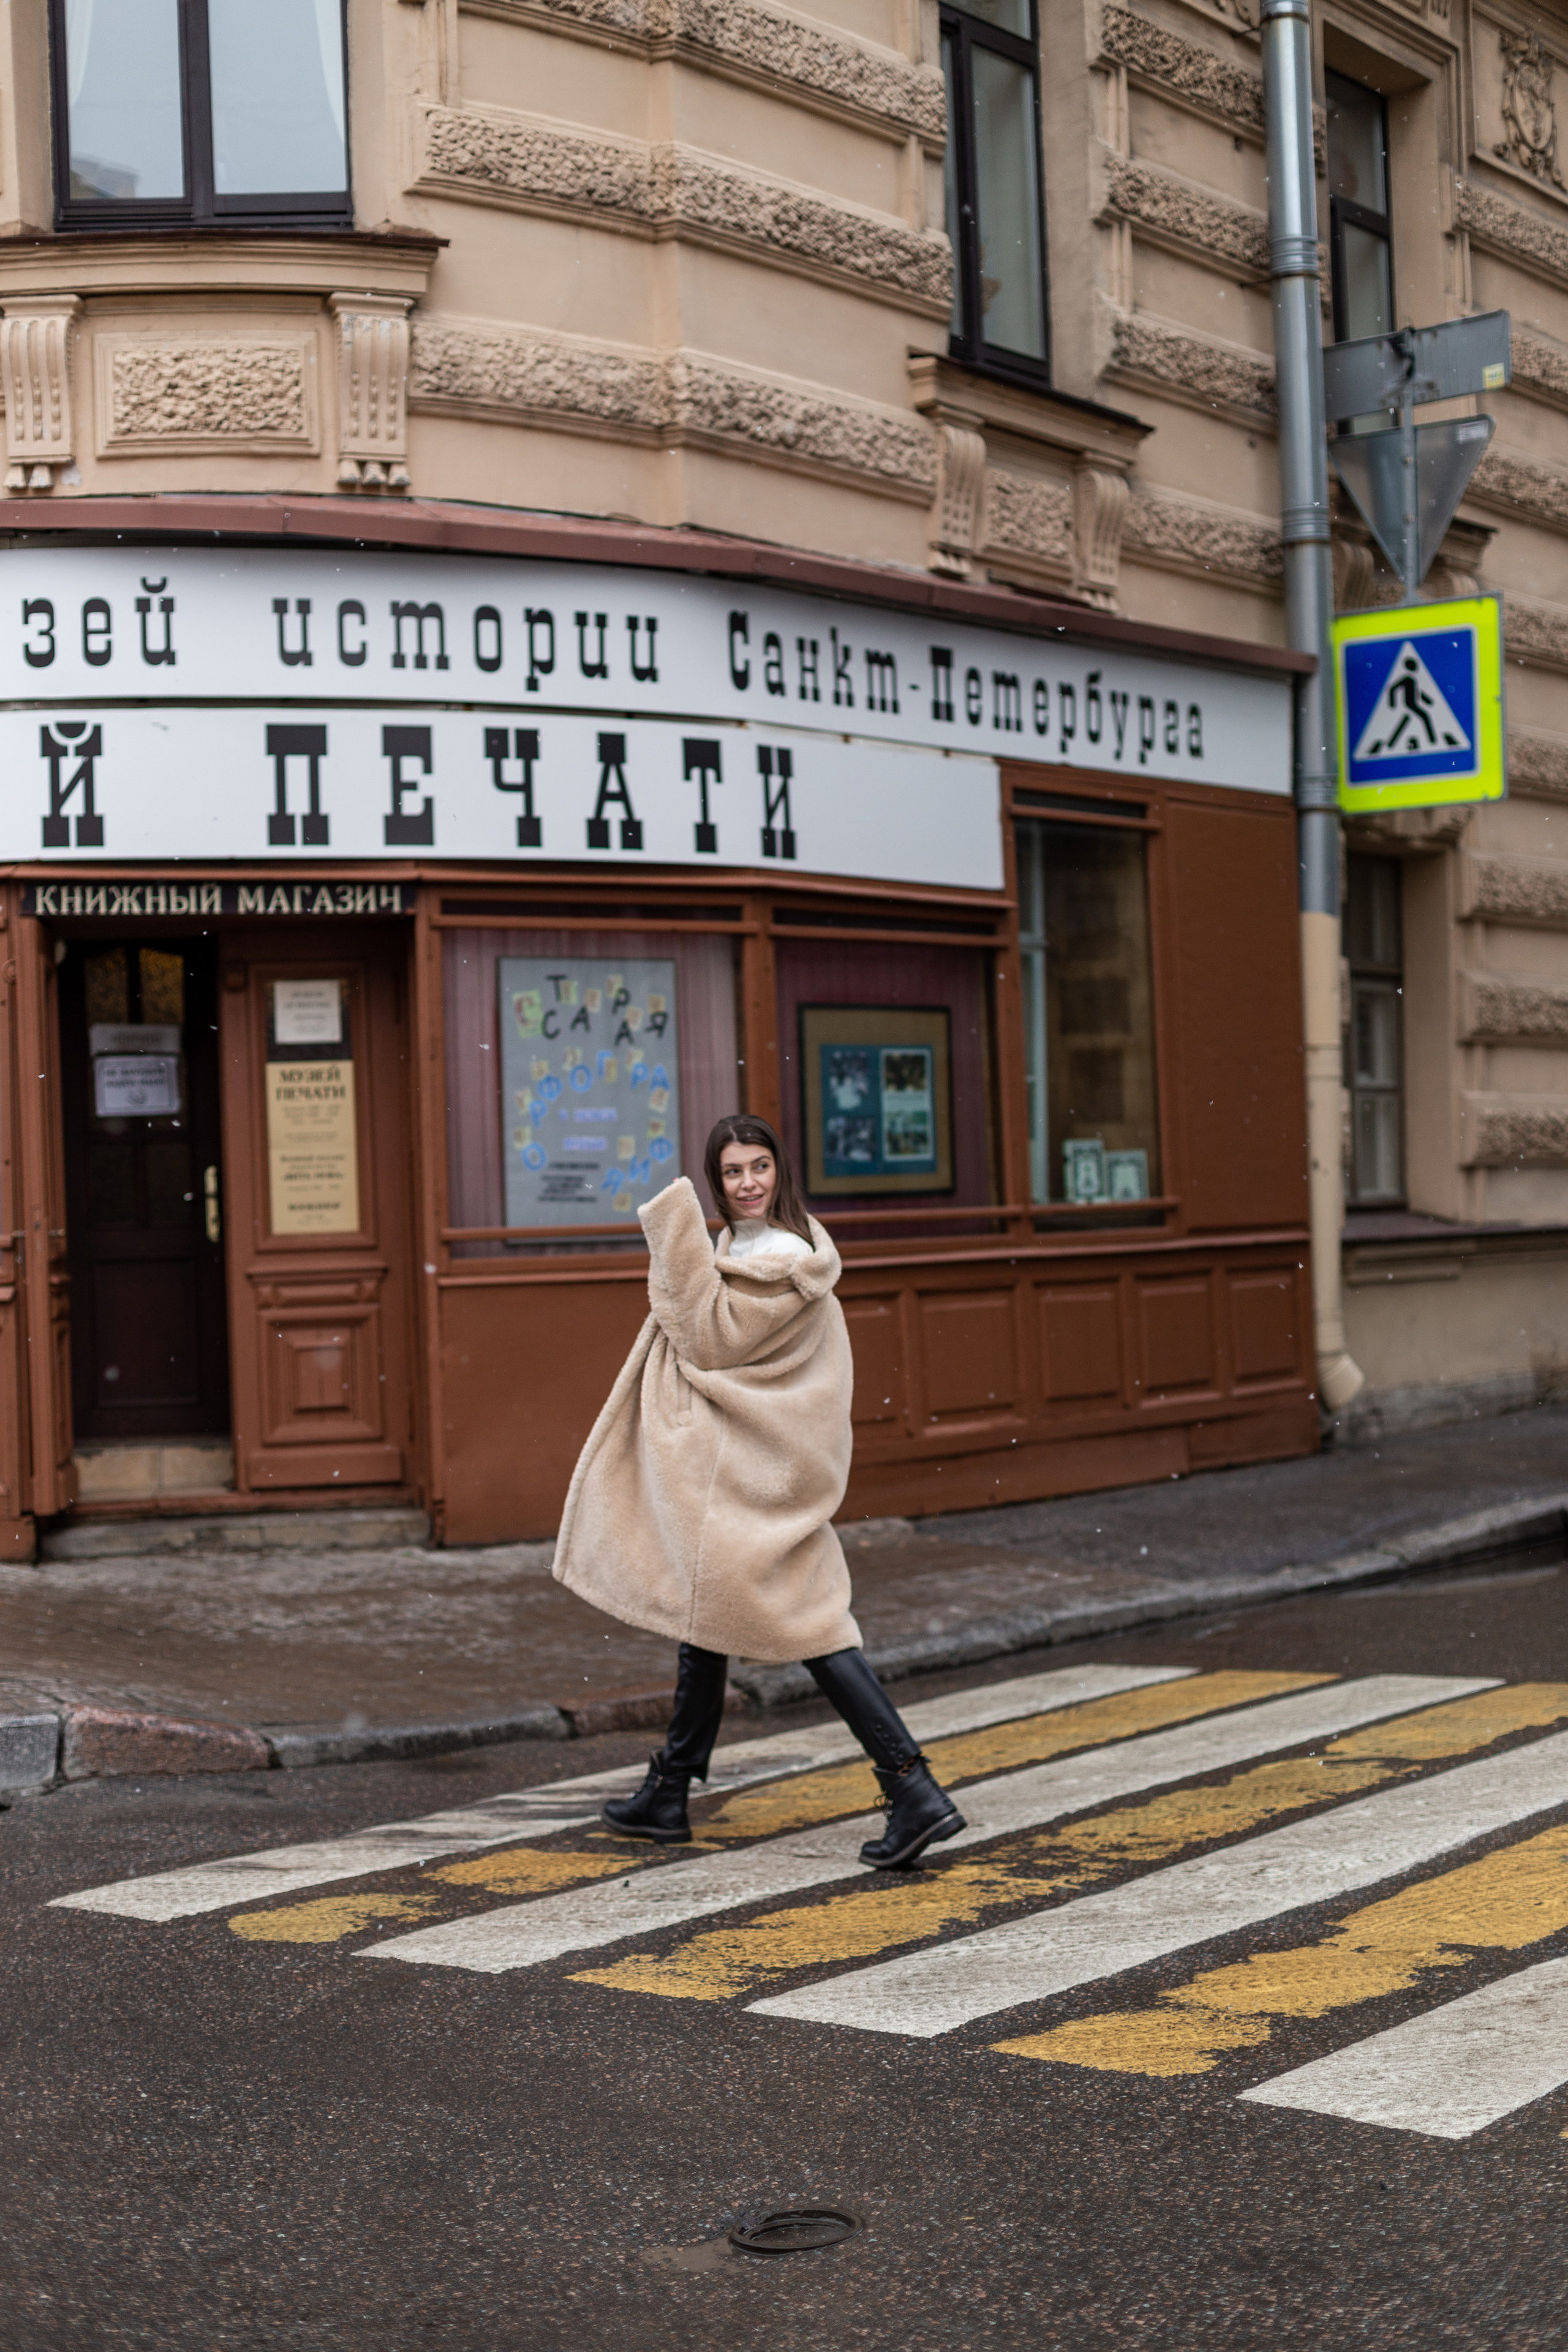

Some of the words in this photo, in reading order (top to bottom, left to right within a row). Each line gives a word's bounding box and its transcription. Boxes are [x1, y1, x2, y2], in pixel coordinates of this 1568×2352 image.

[271, 598, 659, 692] истории
[728, 609, 1204, 766] Санкт-Петербурга
[264, 722, 797, 860] ПЕЧАТИ
[34, 883, 224, 916] КНИЖНЫЙ
[237, 884, 402, 914] МАГАЗИН
[279, 1065, 341, 1083] МУЗЕЙ
[276, 1085, 346, 1101] ПЕЧАТИ
